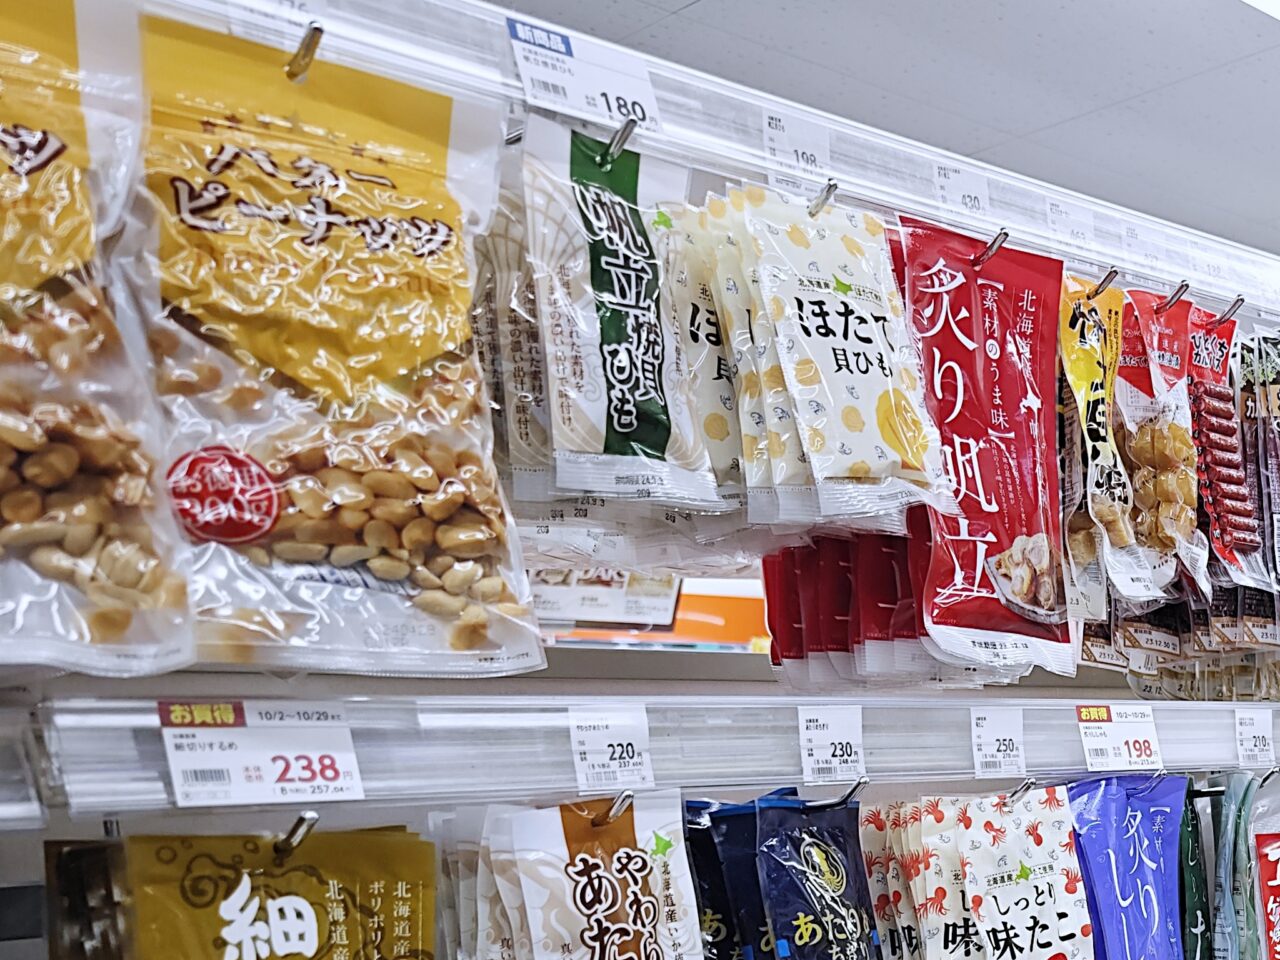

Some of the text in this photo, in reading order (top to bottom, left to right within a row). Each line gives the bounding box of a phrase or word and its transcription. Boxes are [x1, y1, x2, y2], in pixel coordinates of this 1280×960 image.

[600, 92, 647, 122] 180
[168, 176, 455, 257] ピーナッツ
[794, 296, 895, 353] ほたて
[1191, 332, 1228, 358] ひとくち
[831, 347, 893, 378] 貝ひも
[168, 703, 237, 725] お買得
[1080, 707, 1107, 721] お買得
[607, 742, 635, 761] 220
[830, 741, 853, 758] 230
[996, 738, 1015, 753] 250
[1123, 739, 1153, 759] 198
[1253, 735, 1267, 748] 210
[271, 755, 342, 784] 238
[1121, 805, 1159, 937] 炙り
[991, 883, 1057, 917] しっとり
